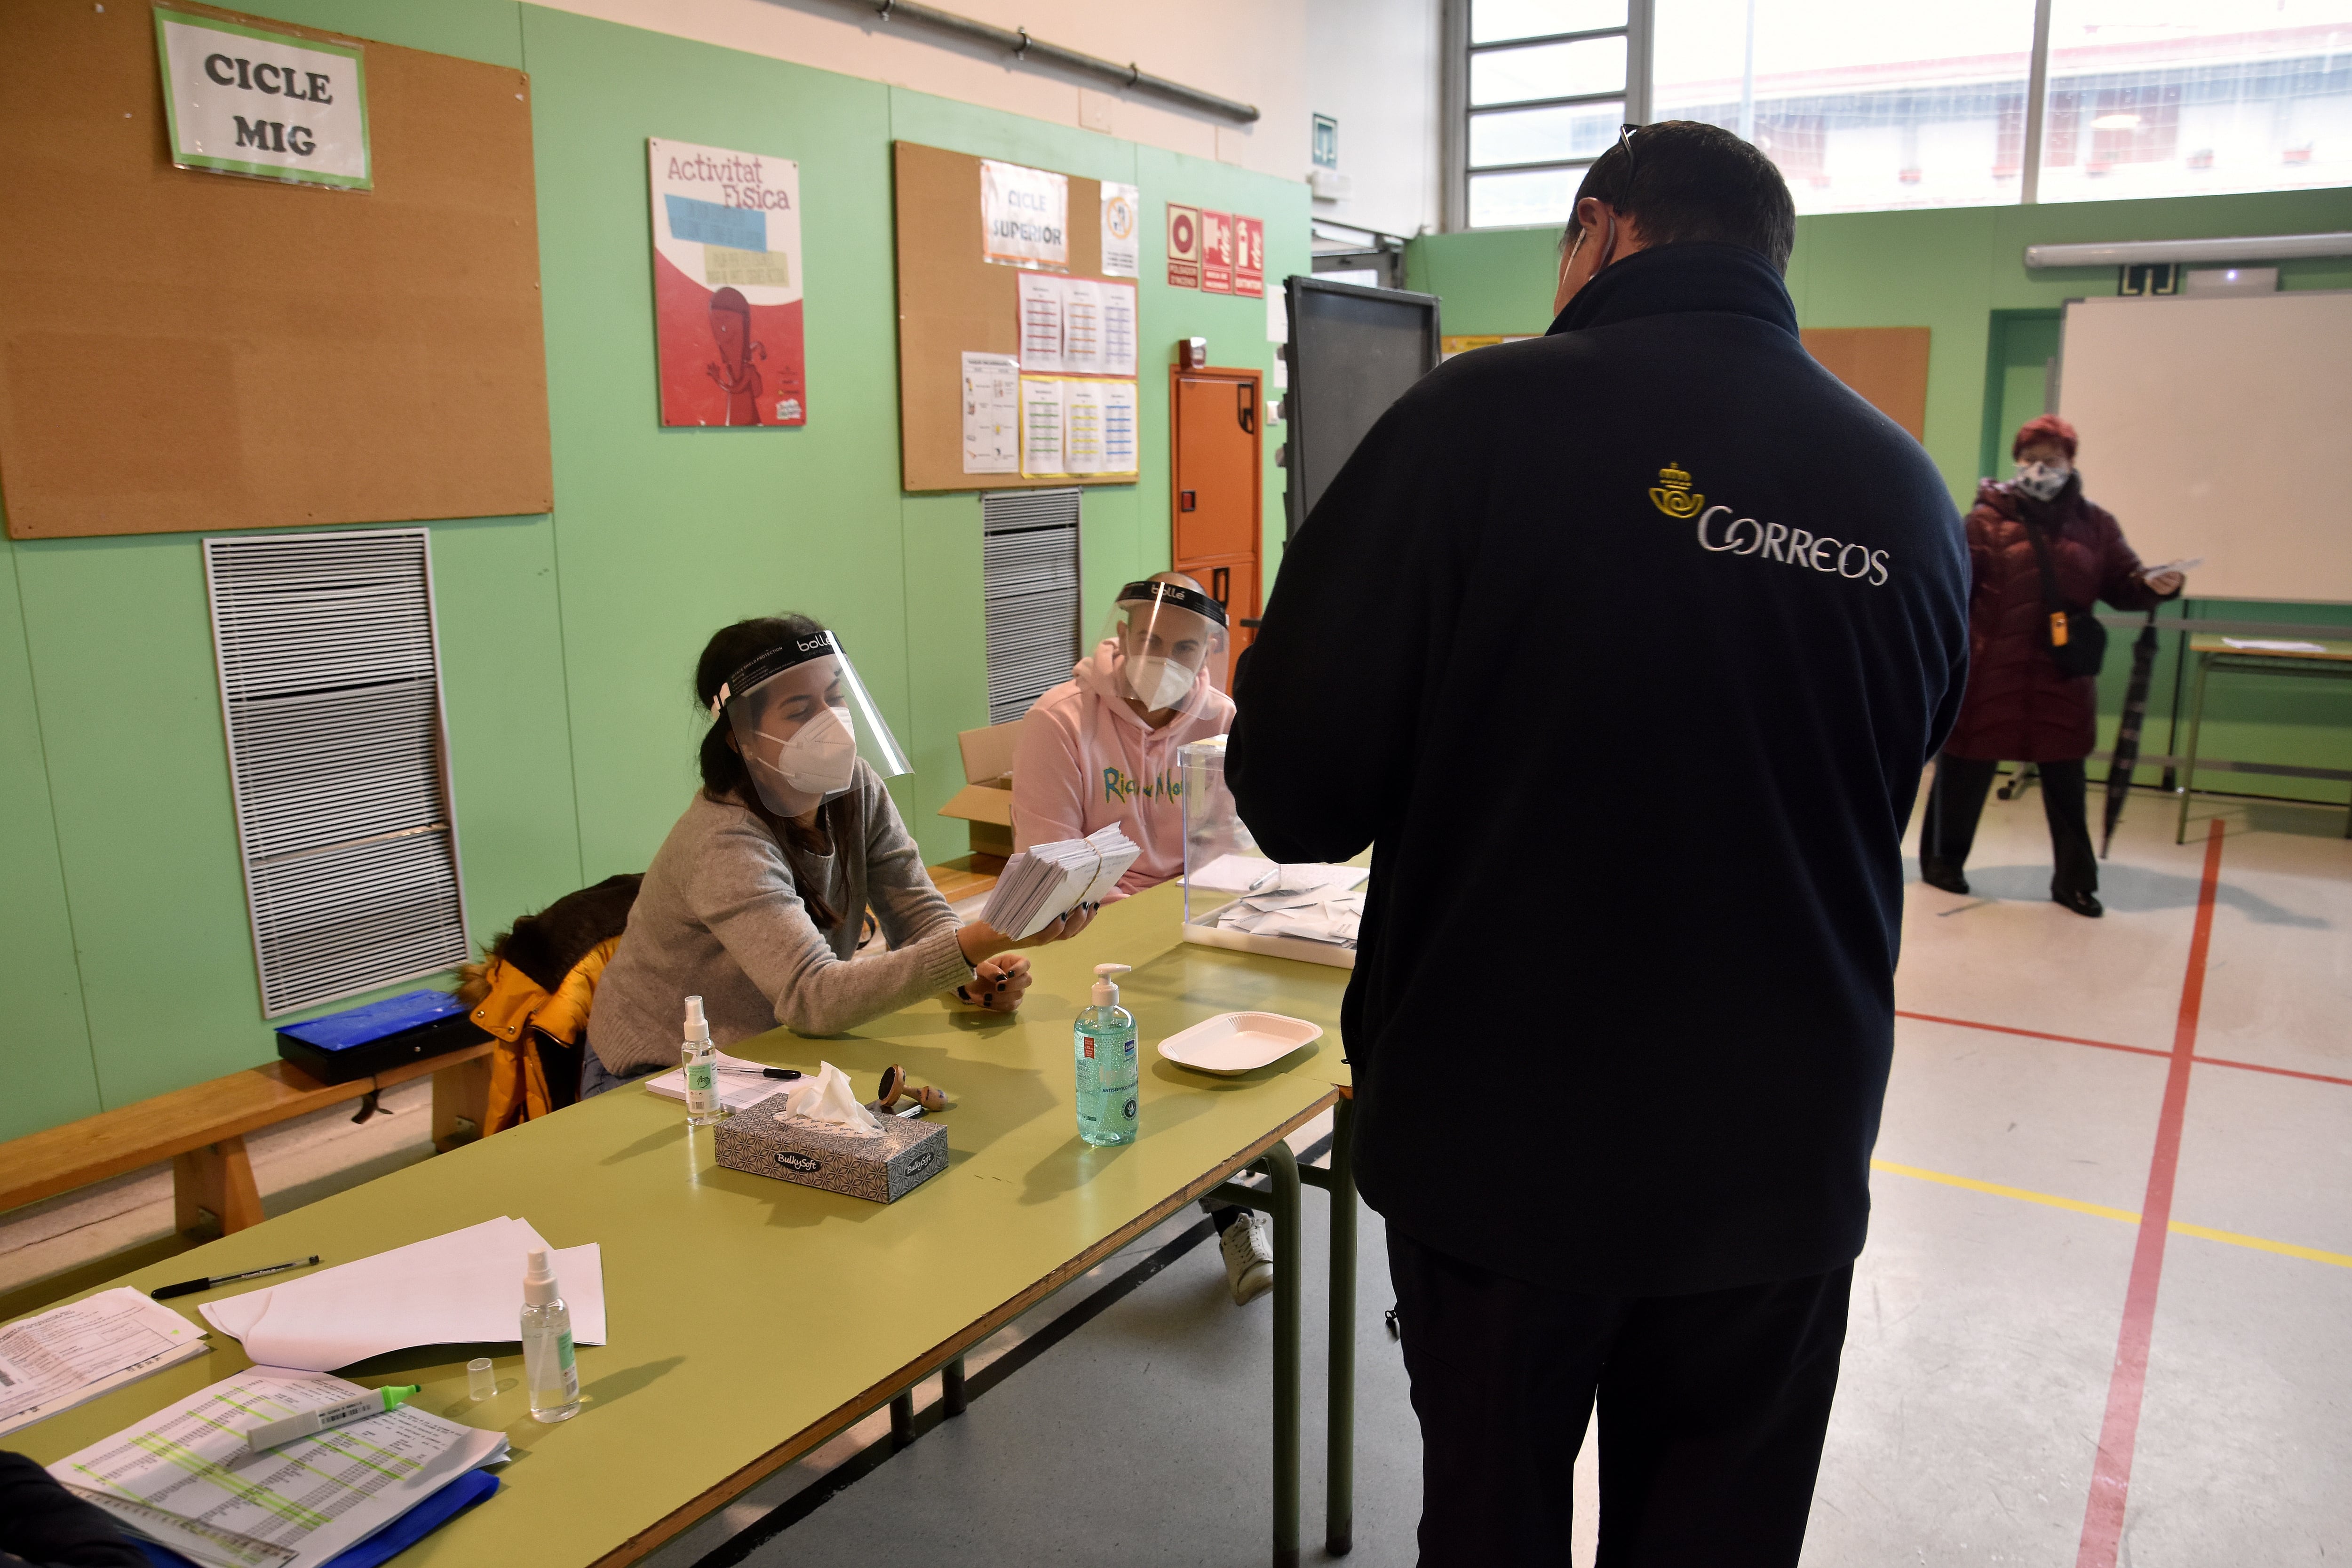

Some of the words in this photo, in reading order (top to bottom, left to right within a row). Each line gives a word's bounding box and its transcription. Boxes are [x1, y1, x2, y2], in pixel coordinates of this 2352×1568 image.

[205, 53, 333, 105] CICLE
[232, 115, 316, 156] MIG
[667, 153, 763, 184] Activitat
[1008, 190, 1047, 211] CICLE
[993, 220, 1062, 245] SUPERIOR
[1697, 506, 1890, 586] CORREOS
[744, 659, 757, 670] SHIELD
[756, 646, 783, 662] PROTECTION
[776, 1153, 817, 1170] BulkySoft
[906, 1153, 931, 1174] BulkySoft
